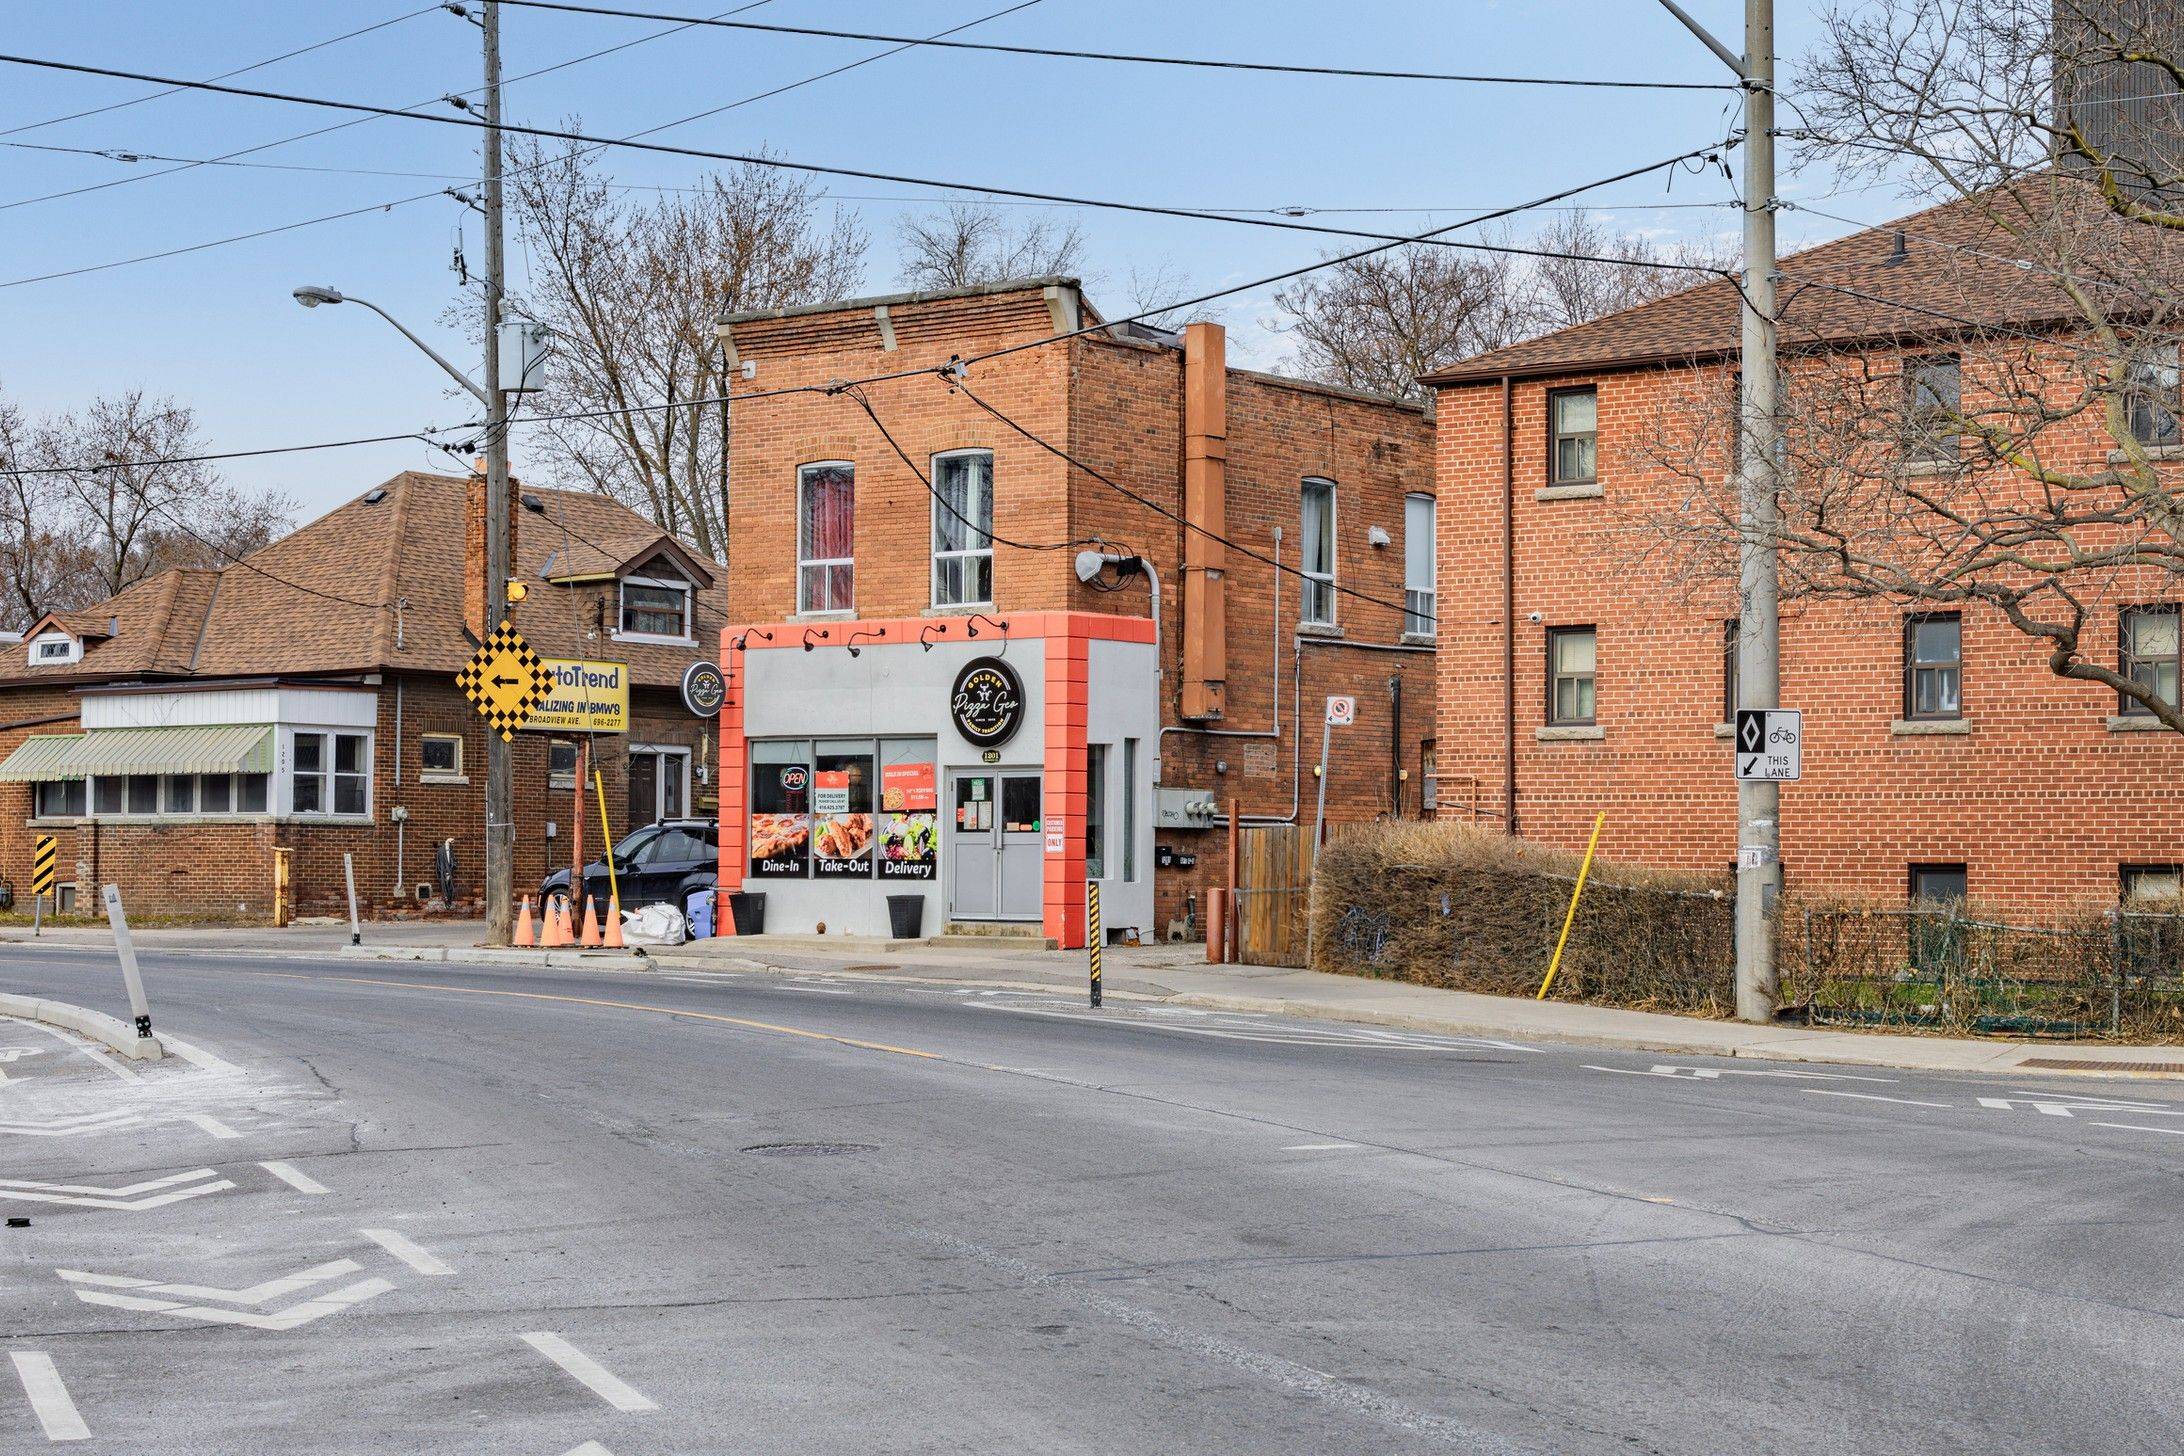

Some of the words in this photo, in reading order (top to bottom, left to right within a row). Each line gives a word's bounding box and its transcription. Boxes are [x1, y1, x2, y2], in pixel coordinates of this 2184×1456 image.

[552, 665, 619, 689] toTrend
[967, 674, 1002, 689] GOLDEN
[537, 700, 574, 712] ALIZING
[577, 701, 586, 713] IN
[953, 692, 990, 718] Pizza
[529, 715, 566, 724] BROADVIEW
[567, 717, 581, 725] AVE.
[1767, 755, 1788, 765] THIS
[783, 772, 805, 784] OPEN
[1765, 767, 1790, 777] LANE
[1047, 838, 1063, 847] ONLY
[762, 859, 799, 872] Dine-In
[819, 859, 869, 872] Take-Out
[885, 860, 932, 878] Delivery
